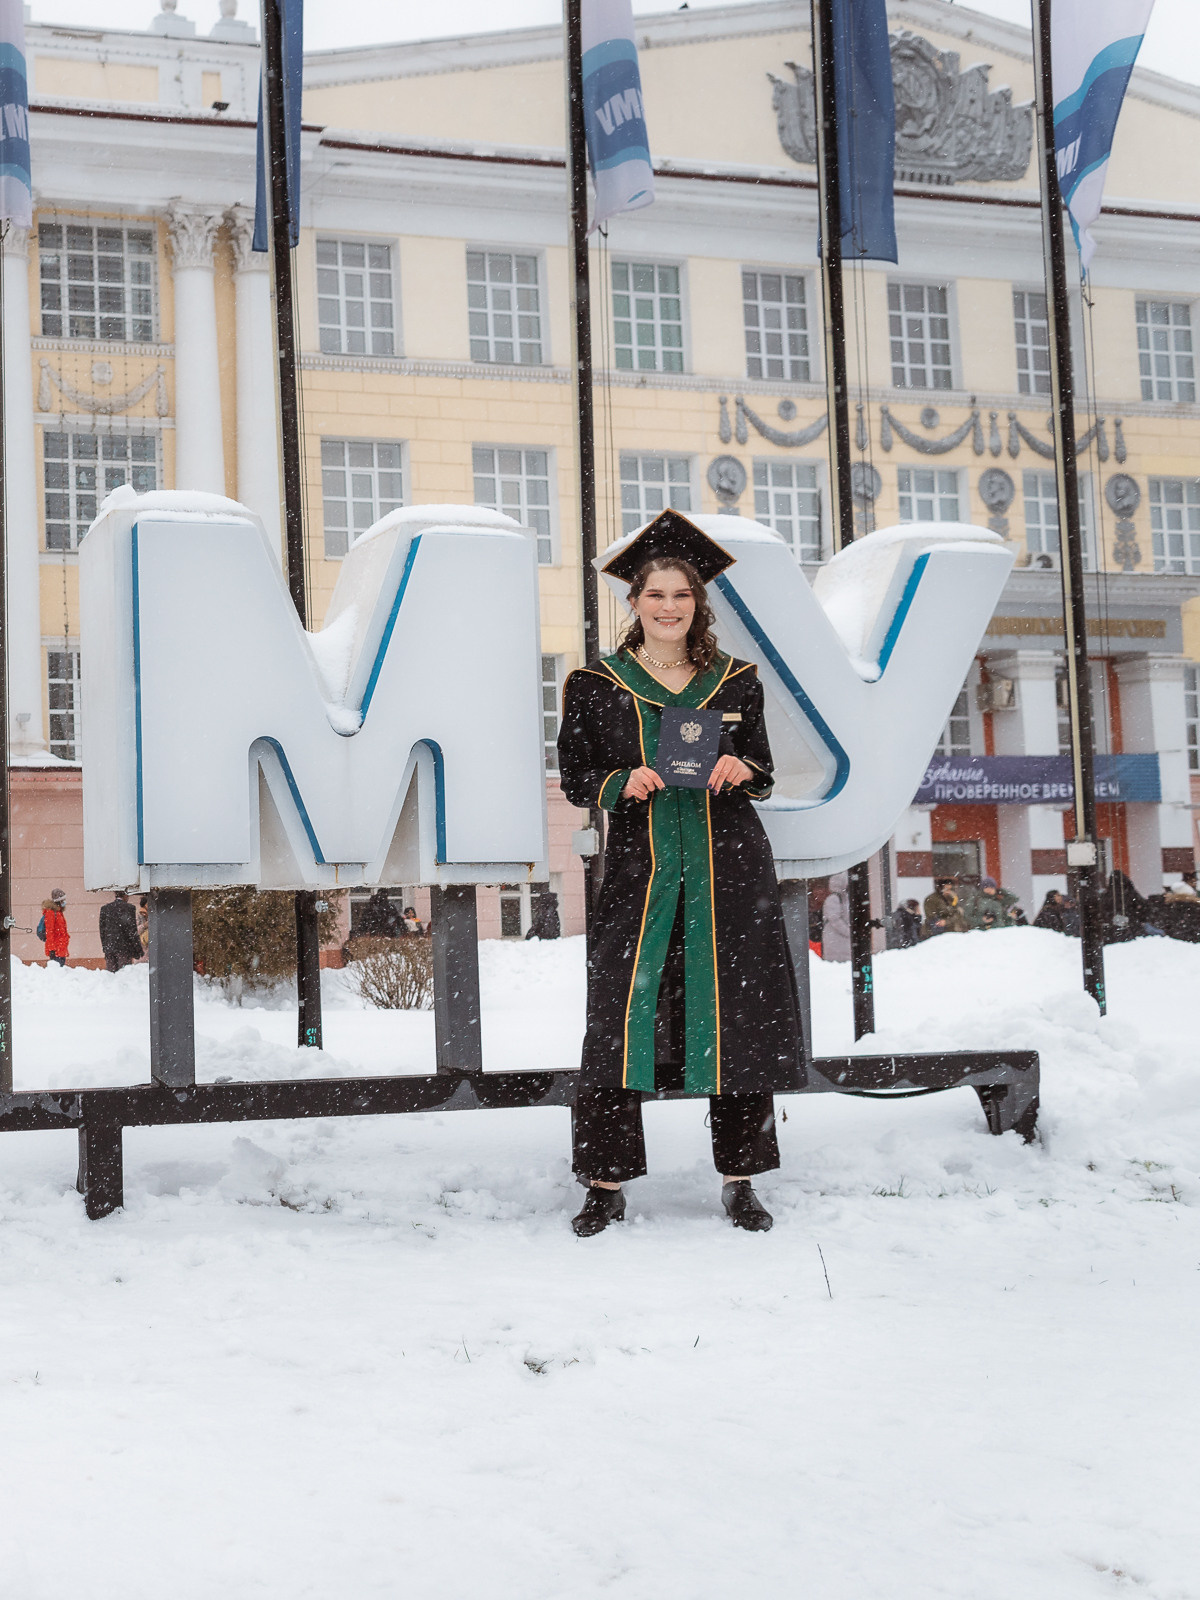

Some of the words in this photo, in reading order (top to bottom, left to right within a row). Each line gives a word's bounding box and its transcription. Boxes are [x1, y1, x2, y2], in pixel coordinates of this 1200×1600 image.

[670, 760, 702, 769] ДИПЛОМ
[934, 782, 1041, 800] ПРОВЕРЕННОЕ
[1042, 782, 1121, 798] ВРЕЕМ
